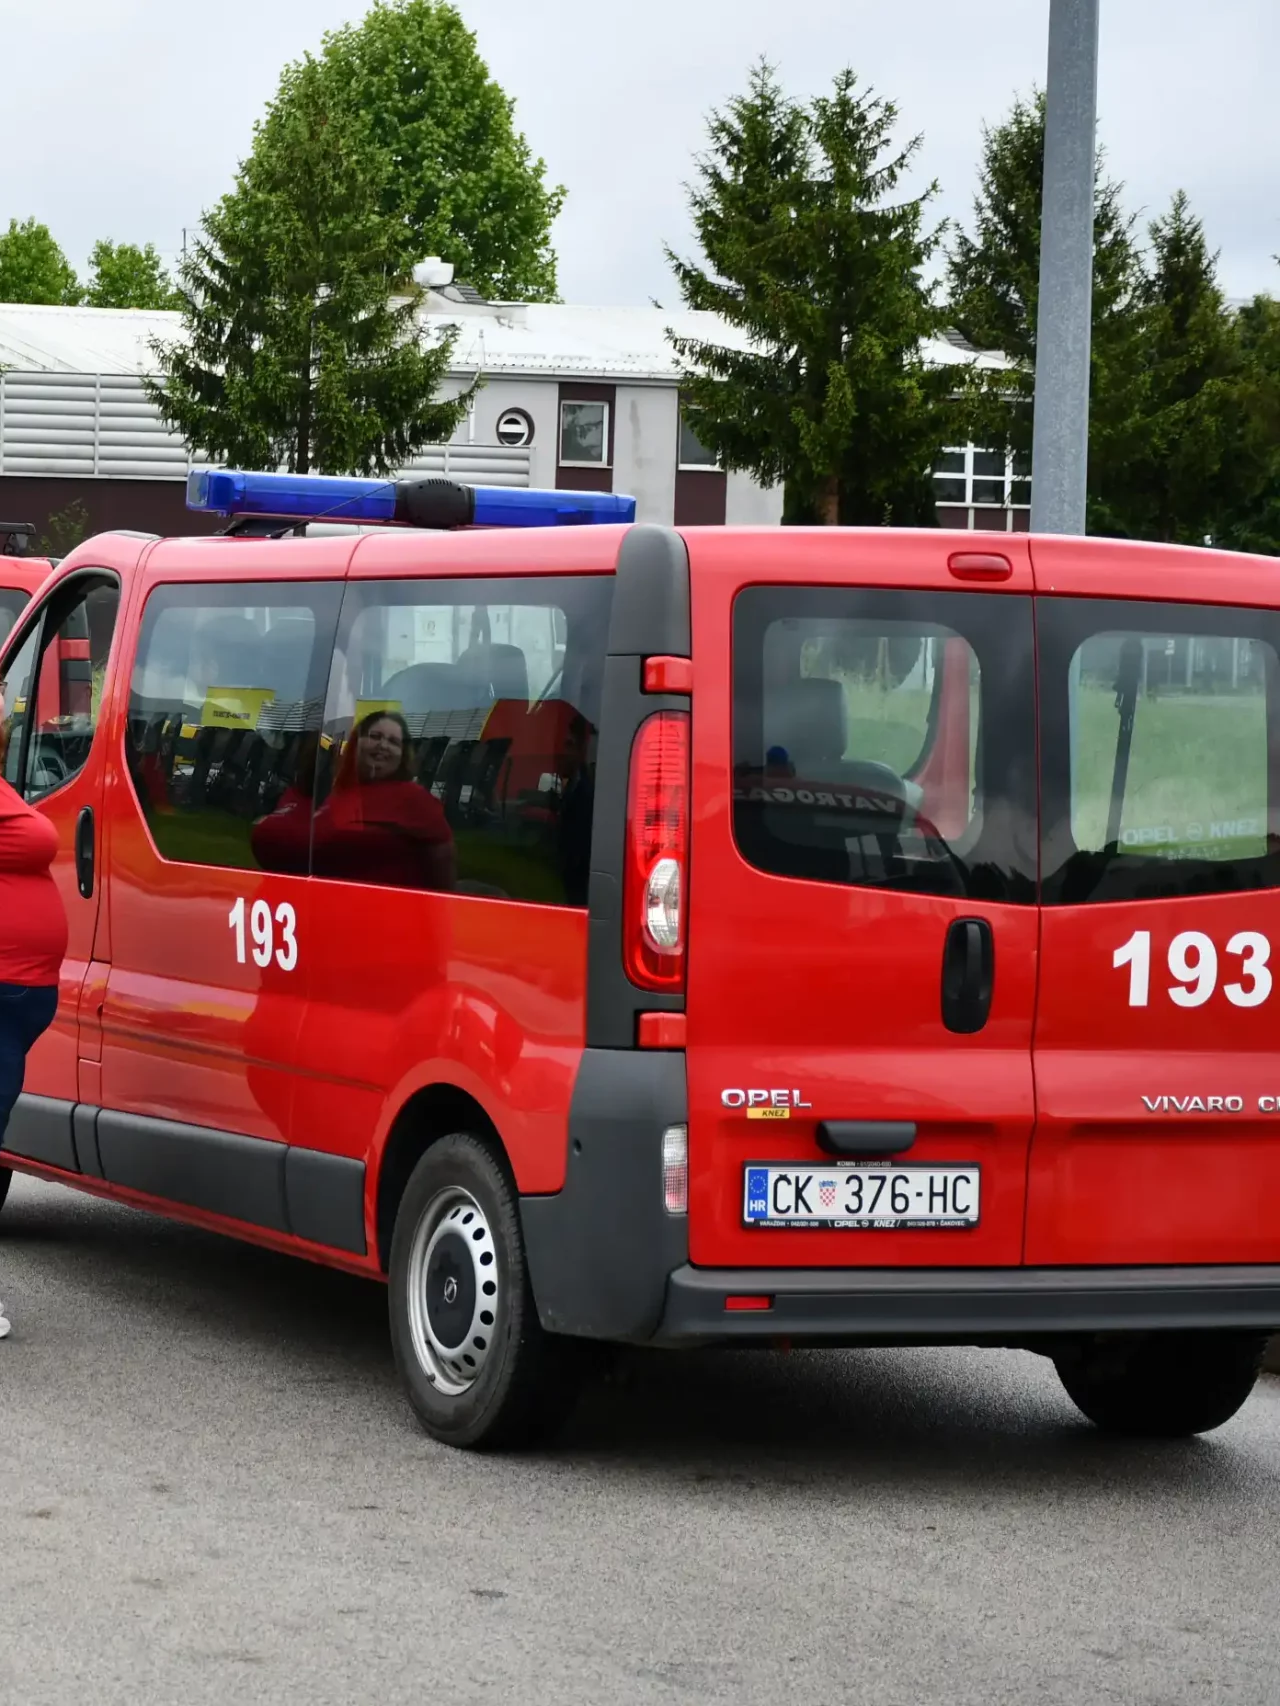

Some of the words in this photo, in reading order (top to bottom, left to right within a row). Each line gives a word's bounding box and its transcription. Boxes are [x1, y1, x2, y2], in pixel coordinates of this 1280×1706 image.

[1122, 826, 1178, 846] OPEL
[1210, 818, 1259, 838] KNEZ
[228, 896, 298, 971] 193
[1113, 930, 1273, 1008] 193
[721, 1088, 812, 1108] OPEL
[1141, 1095, 1243, 1113] VIVARO
[1257, 1096, 1280, 1113] C
[762, 1109, 786, 1117] KNEZ
[773, 1173, 813, 1214] ČK
[749, 1200, 766, 1212] HR
[834, 1220, 860, 1228] OPEL
[873, 1220, 896, 1228] KNEZ
